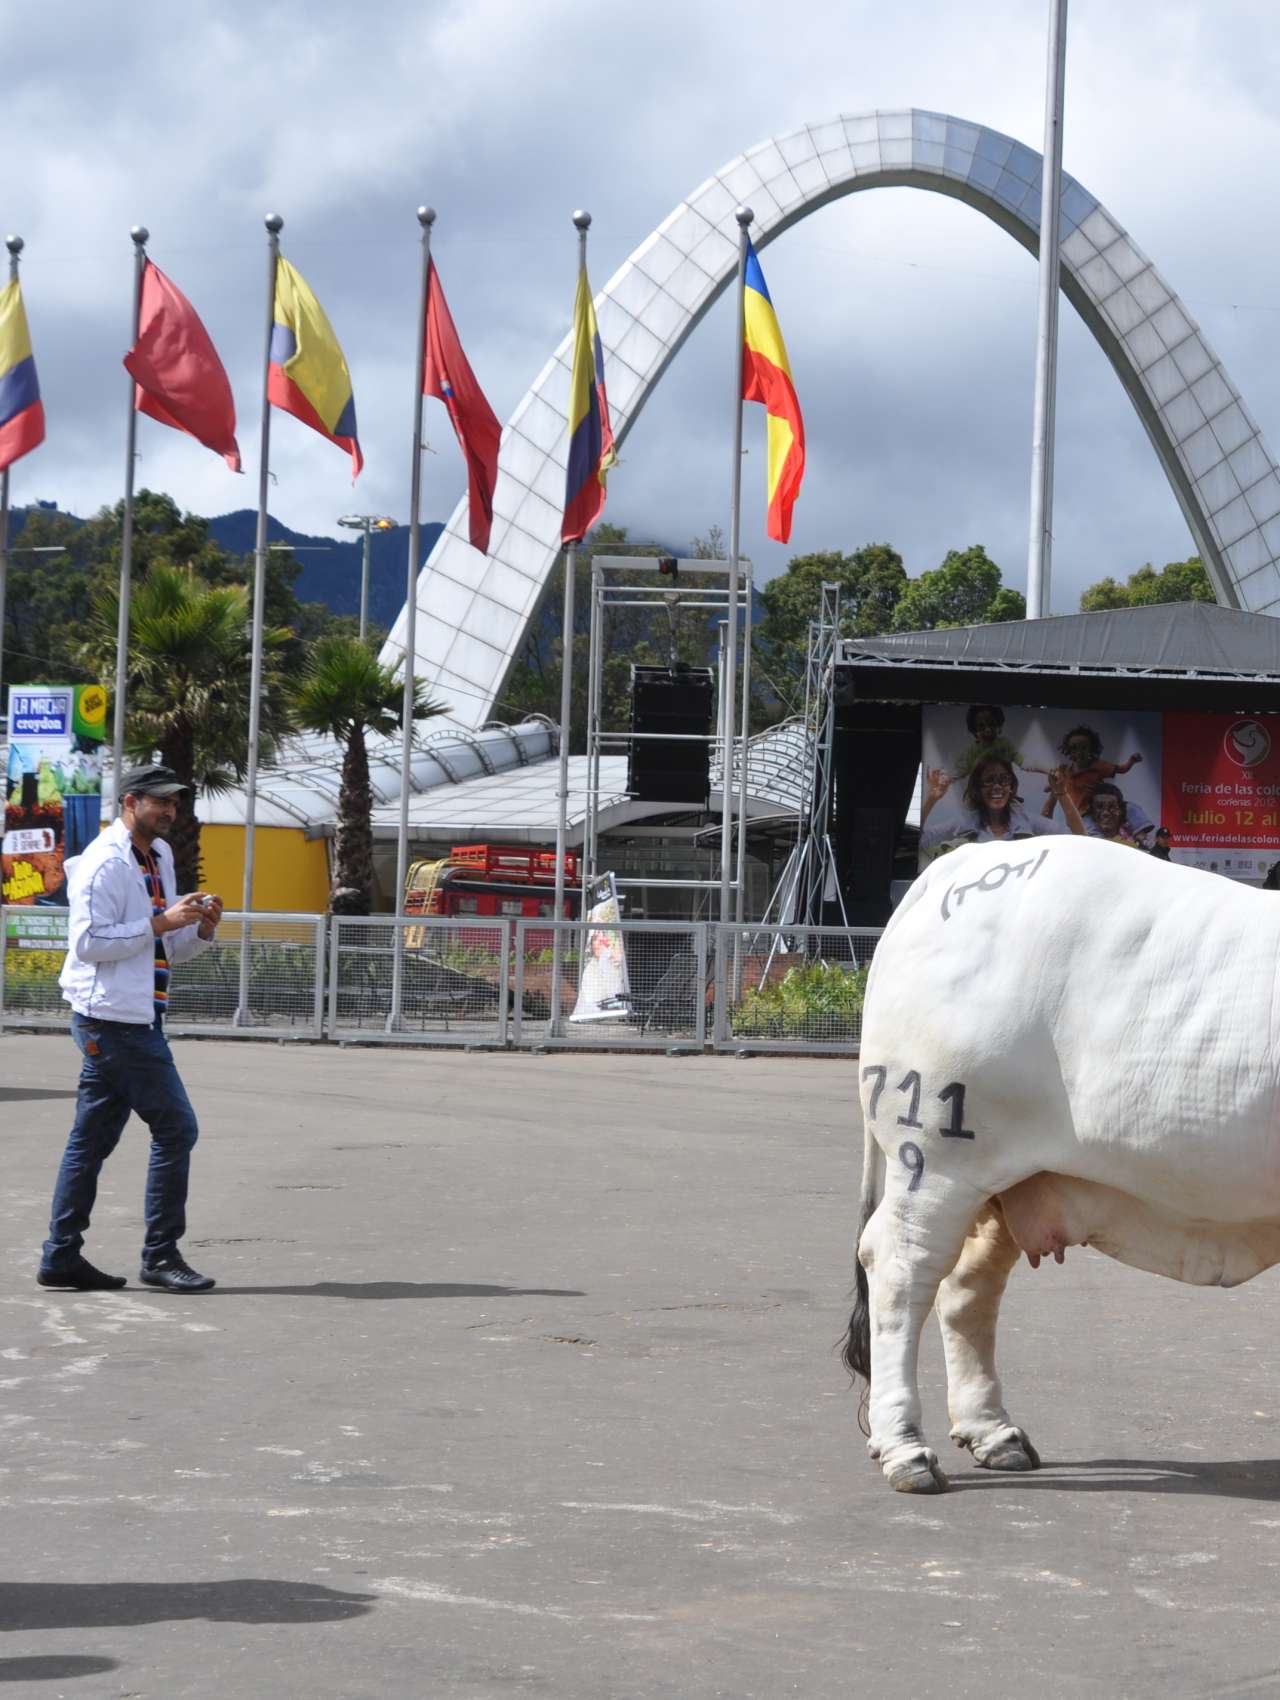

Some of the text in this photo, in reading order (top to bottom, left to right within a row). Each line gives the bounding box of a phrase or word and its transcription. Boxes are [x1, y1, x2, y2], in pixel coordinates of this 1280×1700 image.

[16, 716, 62, 732] croydon
[1182, 782, 1211, 794] feria
[1215, 784, 1231, 794] de
[1235, 784, 1253, 795] las
[1183, 810, 1226, 825] Julio
[1235, 811, 1254, 825] 12
[1262, 811, 1277, 826] al
[899, 1142, 924, 1192] 9
